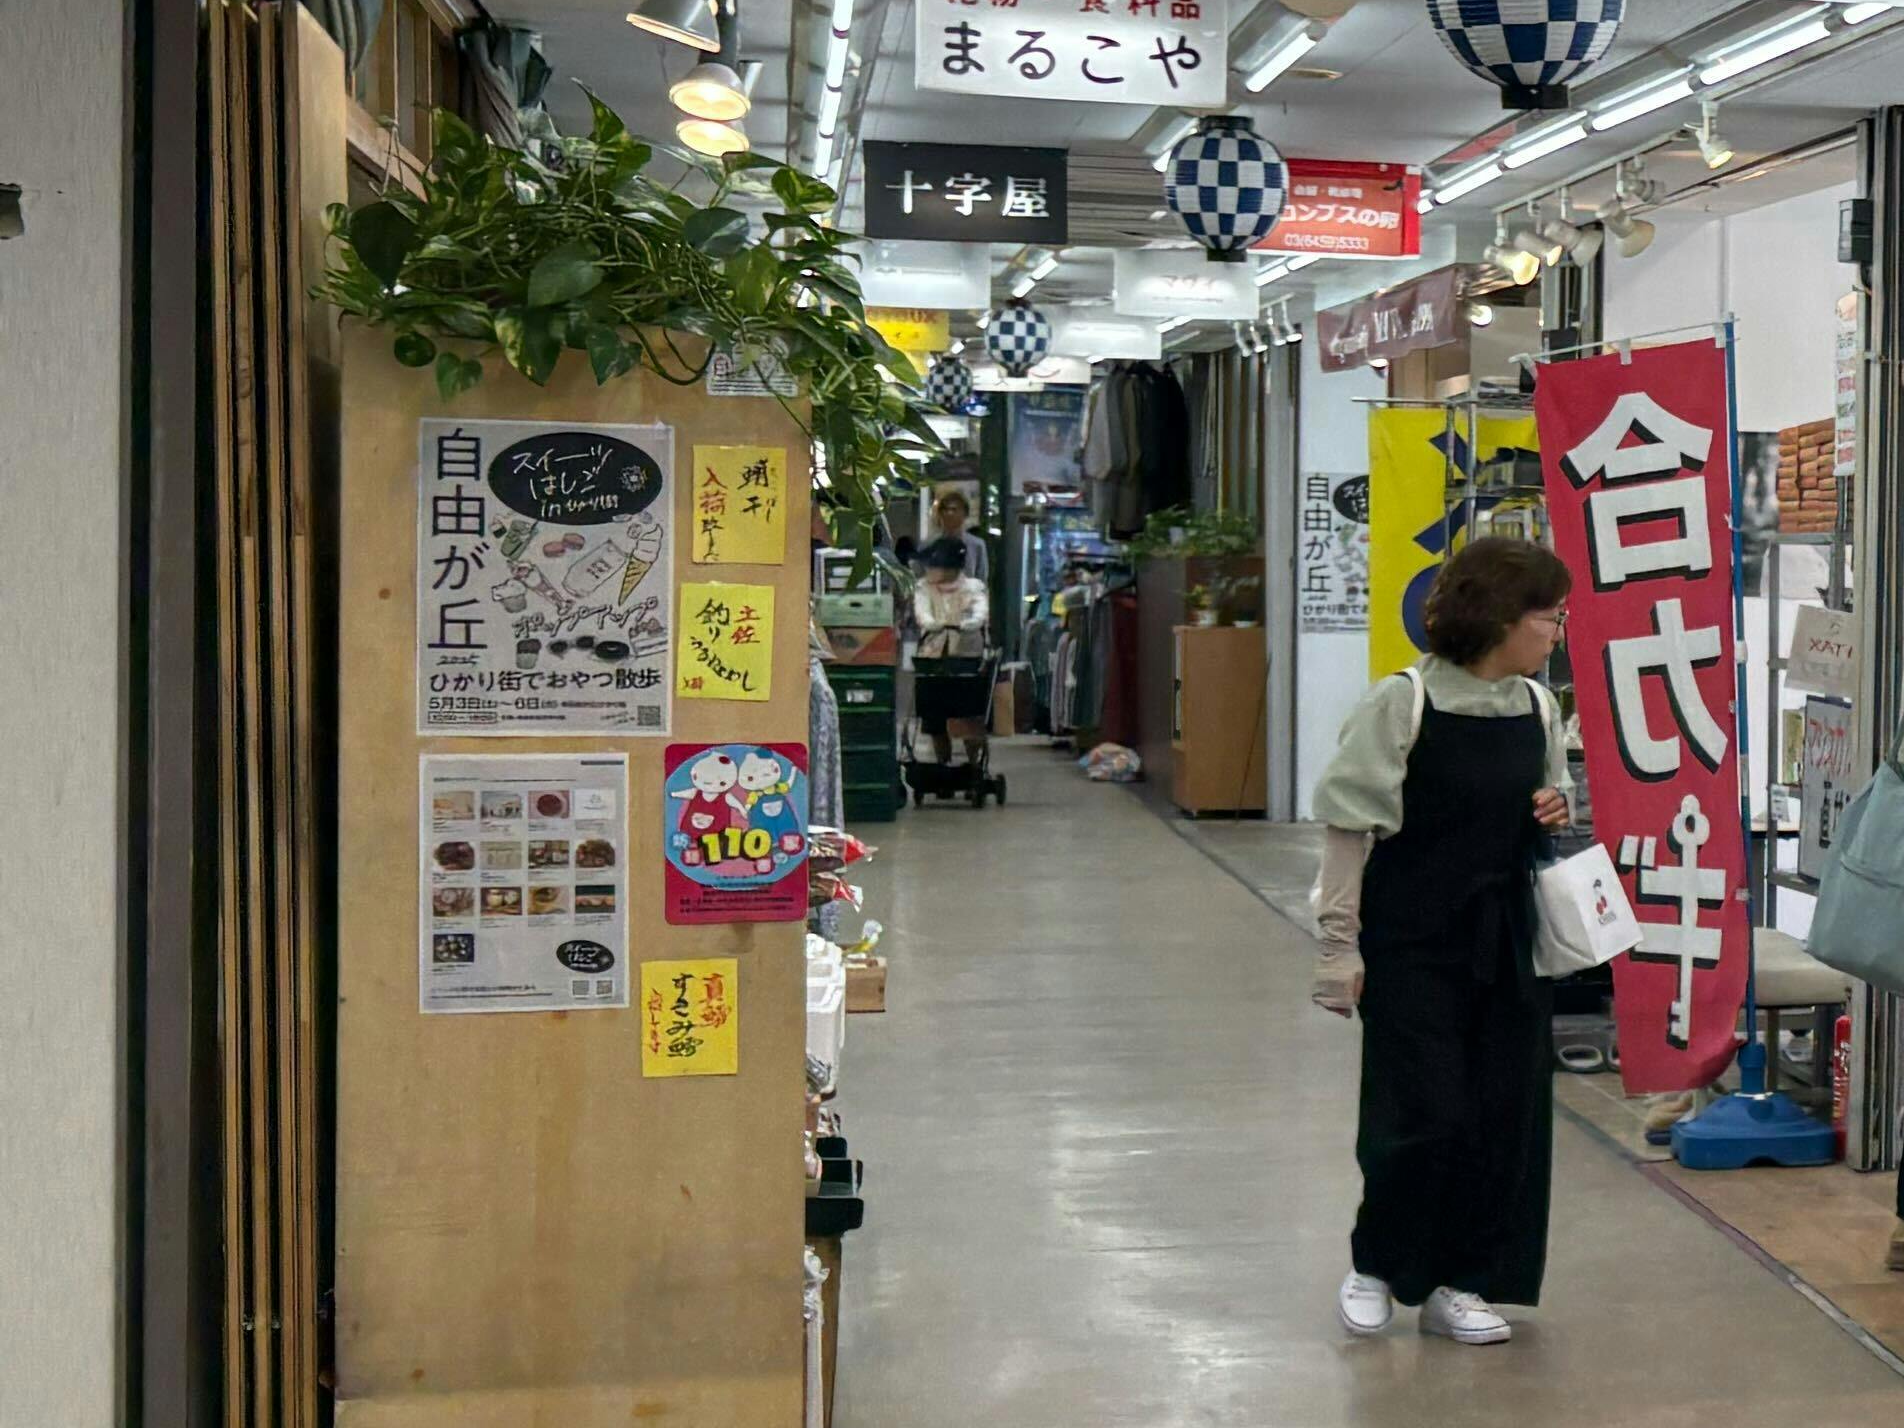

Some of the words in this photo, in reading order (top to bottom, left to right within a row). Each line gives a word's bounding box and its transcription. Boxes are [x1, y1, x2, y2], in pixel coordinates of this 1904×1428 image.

[942, 20, 1201, 89] まるこや
[884, 169, 1050, 218] 十字屋
[512, 444, 614, 475] スイーツ
[427, 427, 490, 650] 自由が丘
[1302, 473, 1334, 592] 自由が丘
[430, 668, 662, 693] ひかり街でおやつ散歩
[702, 828, 772, 864] 110
